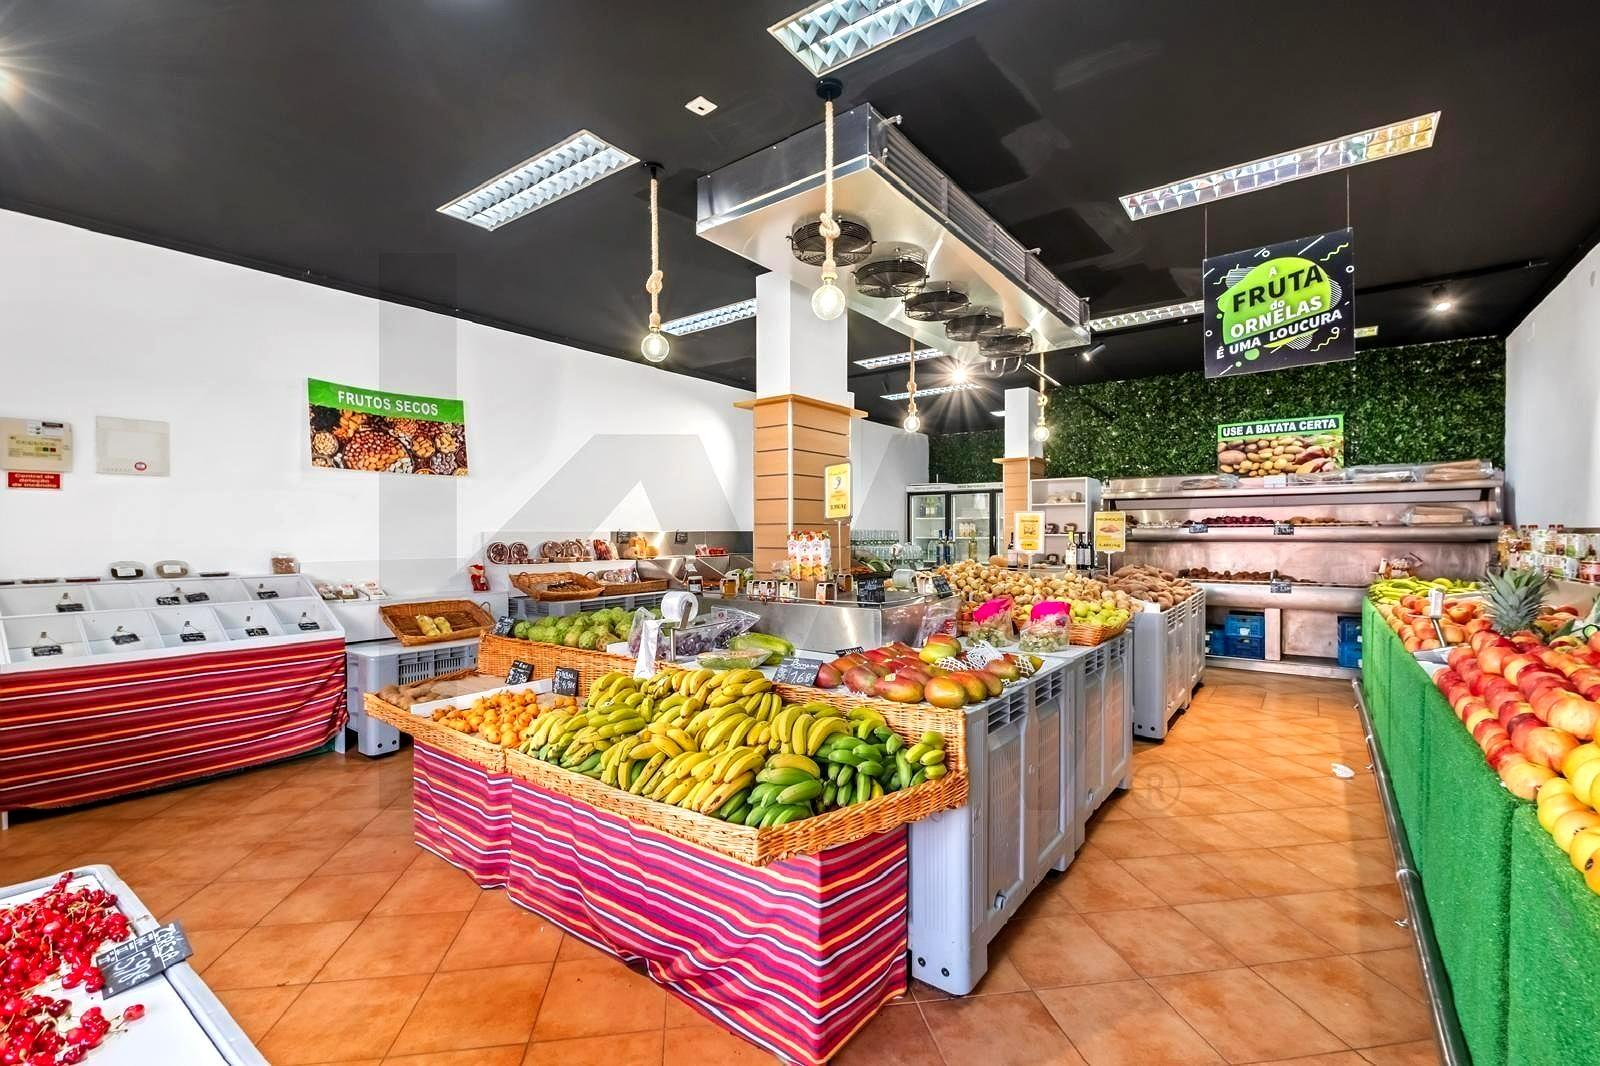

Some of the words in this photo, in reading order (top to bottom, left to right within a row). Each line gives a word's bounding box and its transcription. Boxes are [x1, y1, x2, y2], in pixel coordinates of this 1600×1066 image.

[1269, 266, 1278, 276] A
[1232, 264, 1323, 313] FRUTA
[1230, 295, 1322, 338] ORNELAS
[1270, 299, 1286, 311] do
[1216, 345, 1225, 360] É
[1229, 336, 1262, 355] UMA
[1269, 308, 1343, 342] LOUCURA
[337, 390, 391, 410] FRUTOS
[395, 400, 439, 416] SECOS
[1222, 426, 1244, 437] USE
[1245, 425, 1254, 435] A
[1255, 422, 1297, 434] BATATA
[1298, 418, 1337, 431] CERTA
